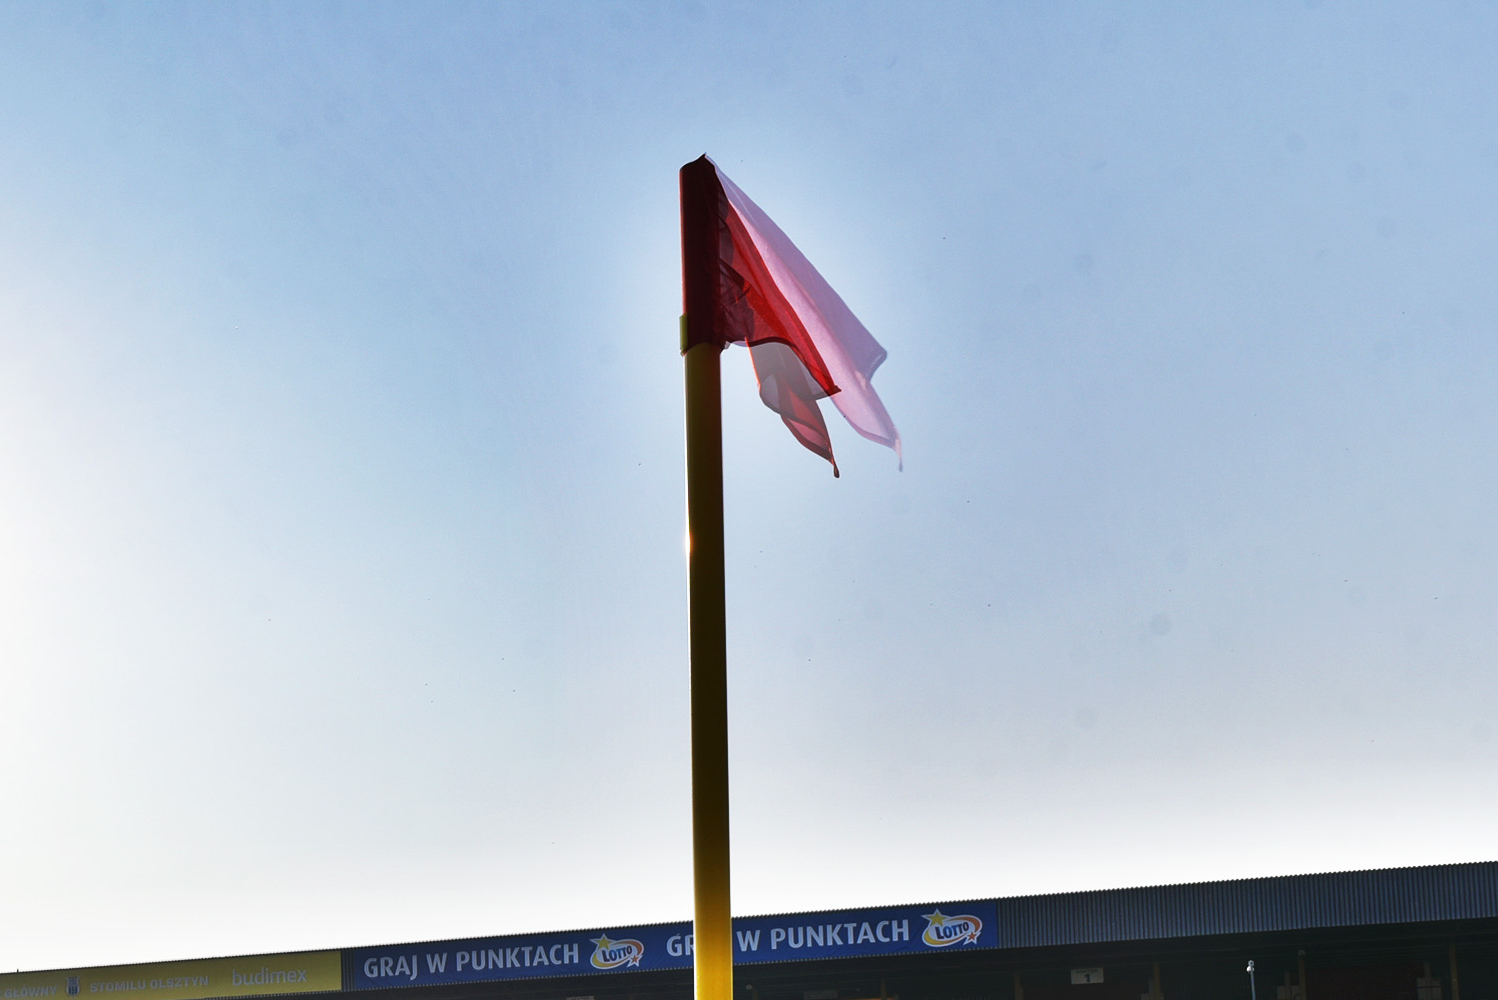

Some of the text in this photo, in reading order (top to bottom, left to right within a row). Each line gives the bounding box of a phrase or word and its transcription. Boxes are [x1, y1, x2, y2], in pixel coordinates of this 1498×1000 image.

[736, 929, 761, 952] W
[770, 919, 910, 950] PUNKTACH
[935, 920, 970, 940] LOTTO
[364, 943, 579, 981] GRAJ W PUNKTACH
[602, 945, 633, 963] LOTTO
[90, 975, 209, 993] STOMILU OLSZTYN
[232, 967, 307, 986] budimex
[1084, 973, 1091, 983] 1
[4, 985, 58, 998] GŁÓWNY
